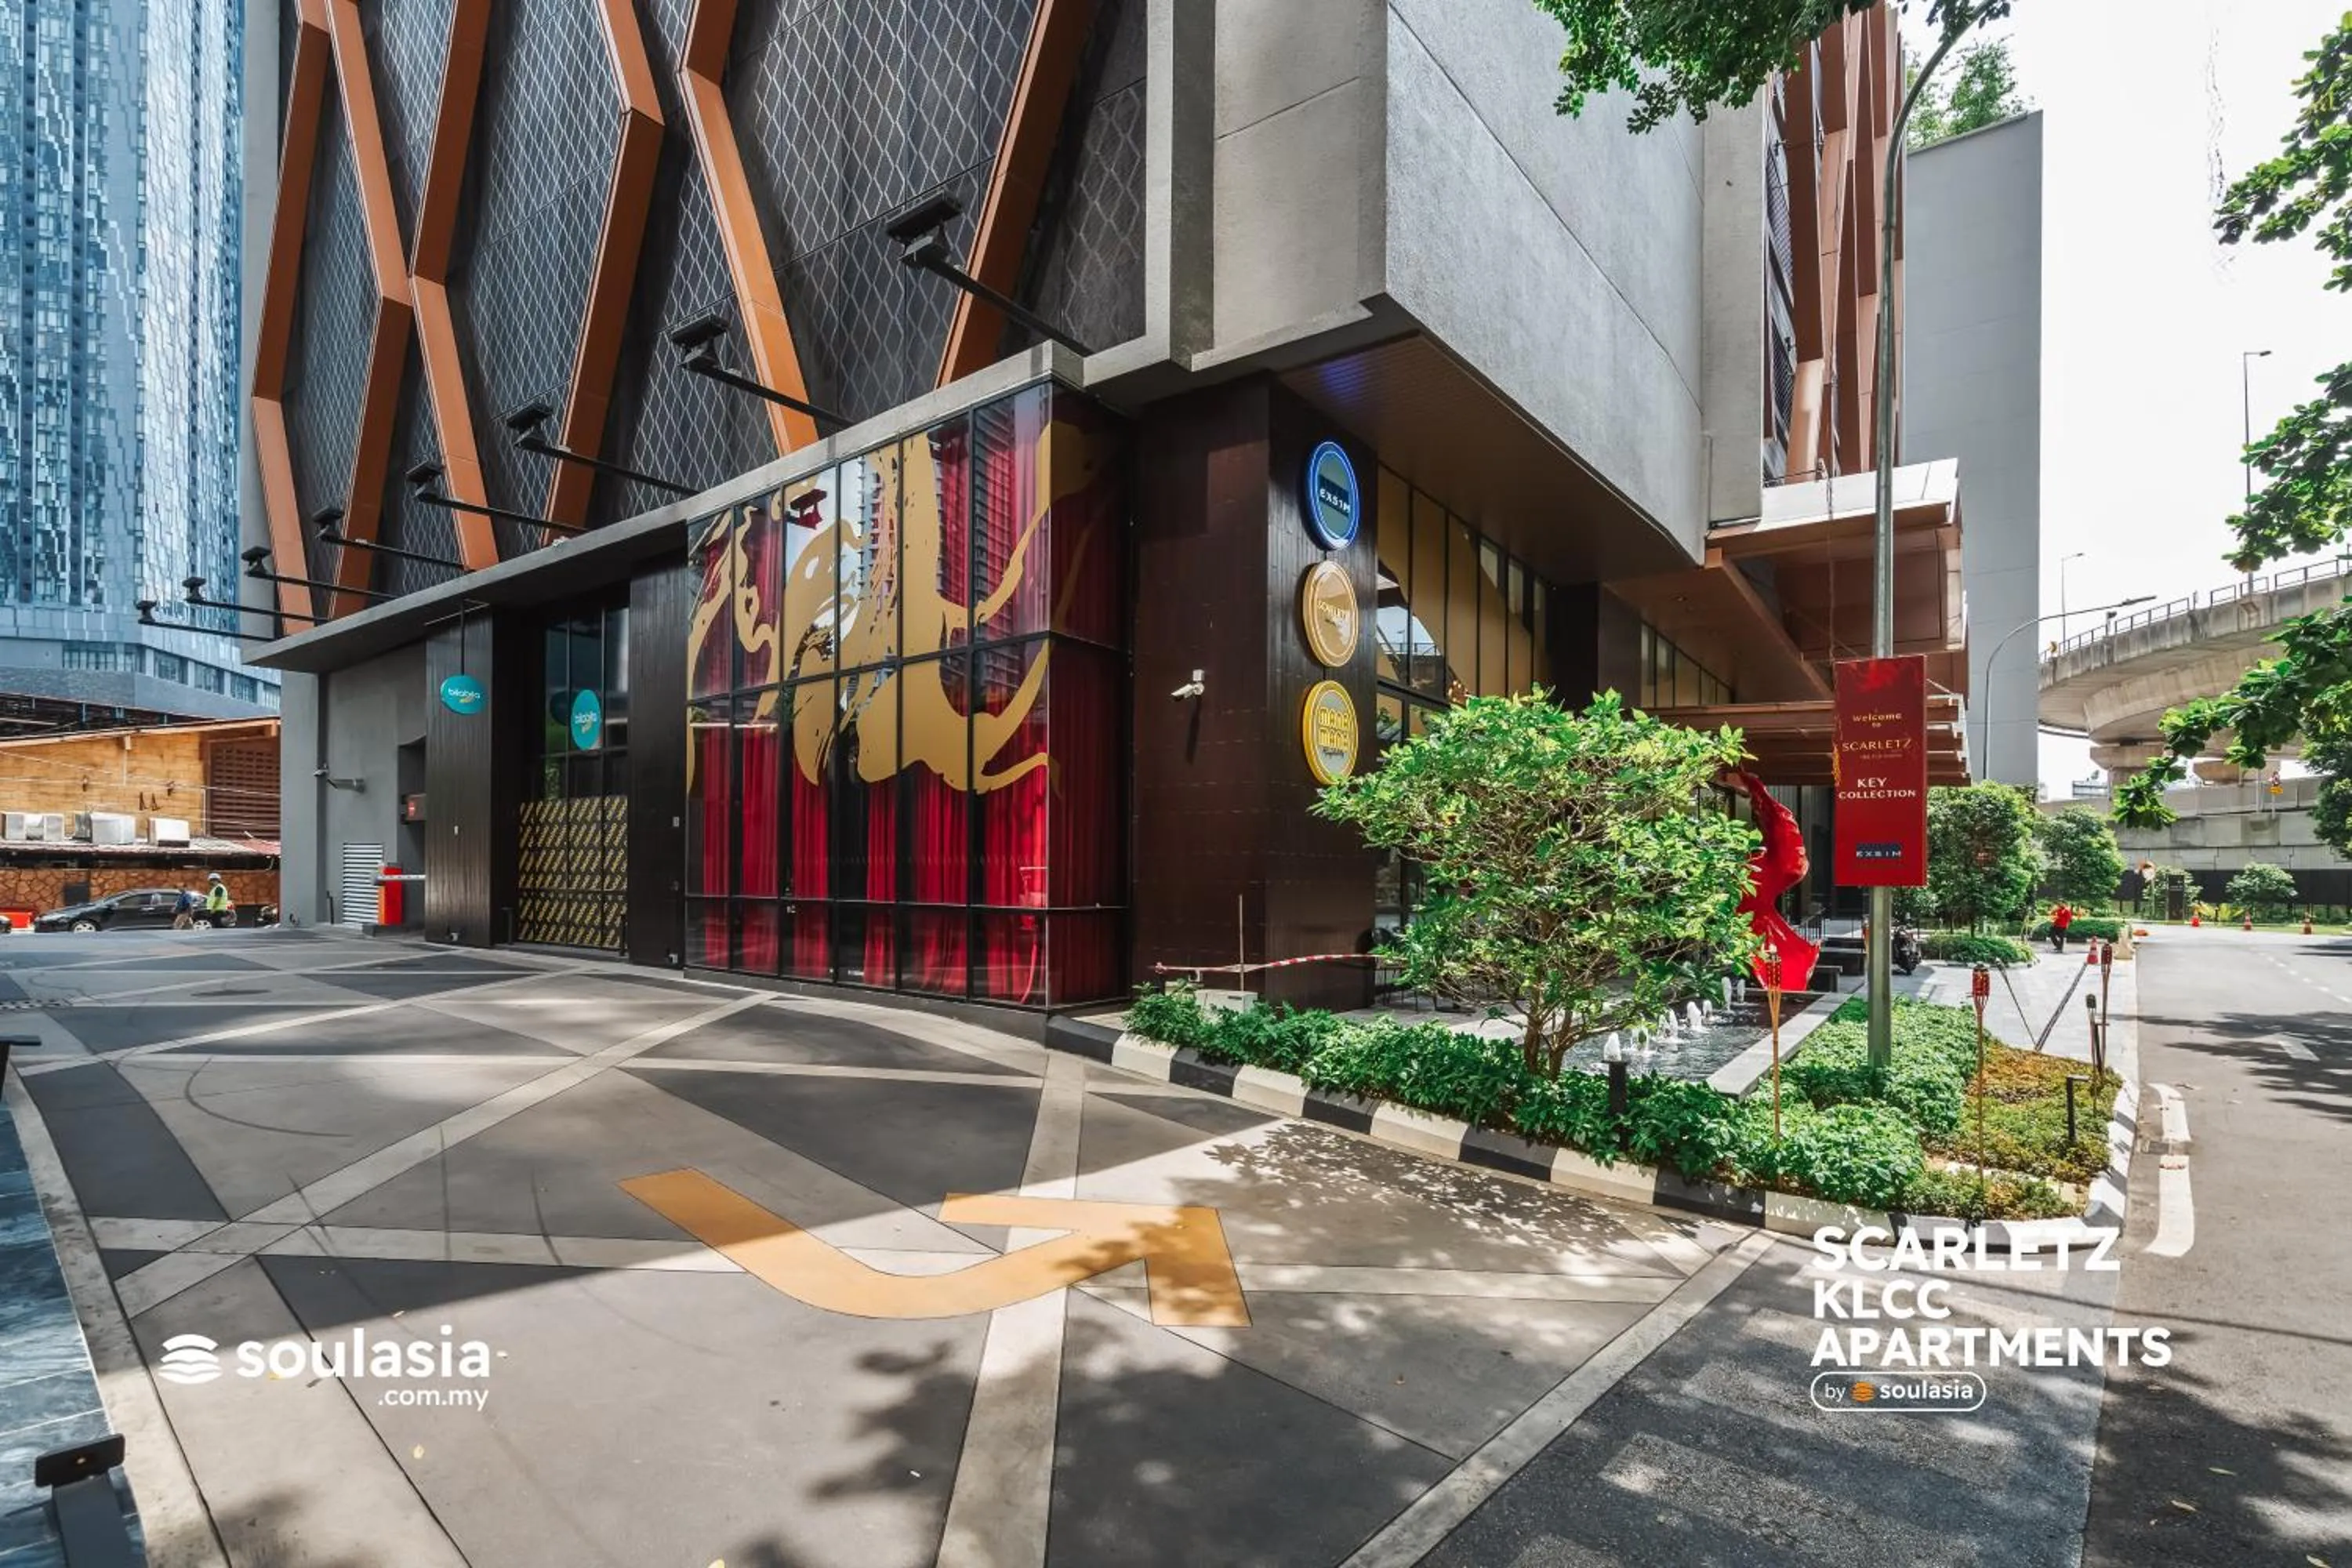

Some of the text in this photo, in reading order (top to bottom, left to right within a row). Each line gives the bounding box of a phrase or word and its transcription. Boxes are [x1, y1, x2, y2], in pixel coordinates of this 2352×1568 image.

[1853, 713, 1902, 722] welcome
[1842, 738, 1911, 753] SCARLETZ
[1857, 777, 1887, 789] KEY
[1838, 789, 1916, 800] COLLECTION
